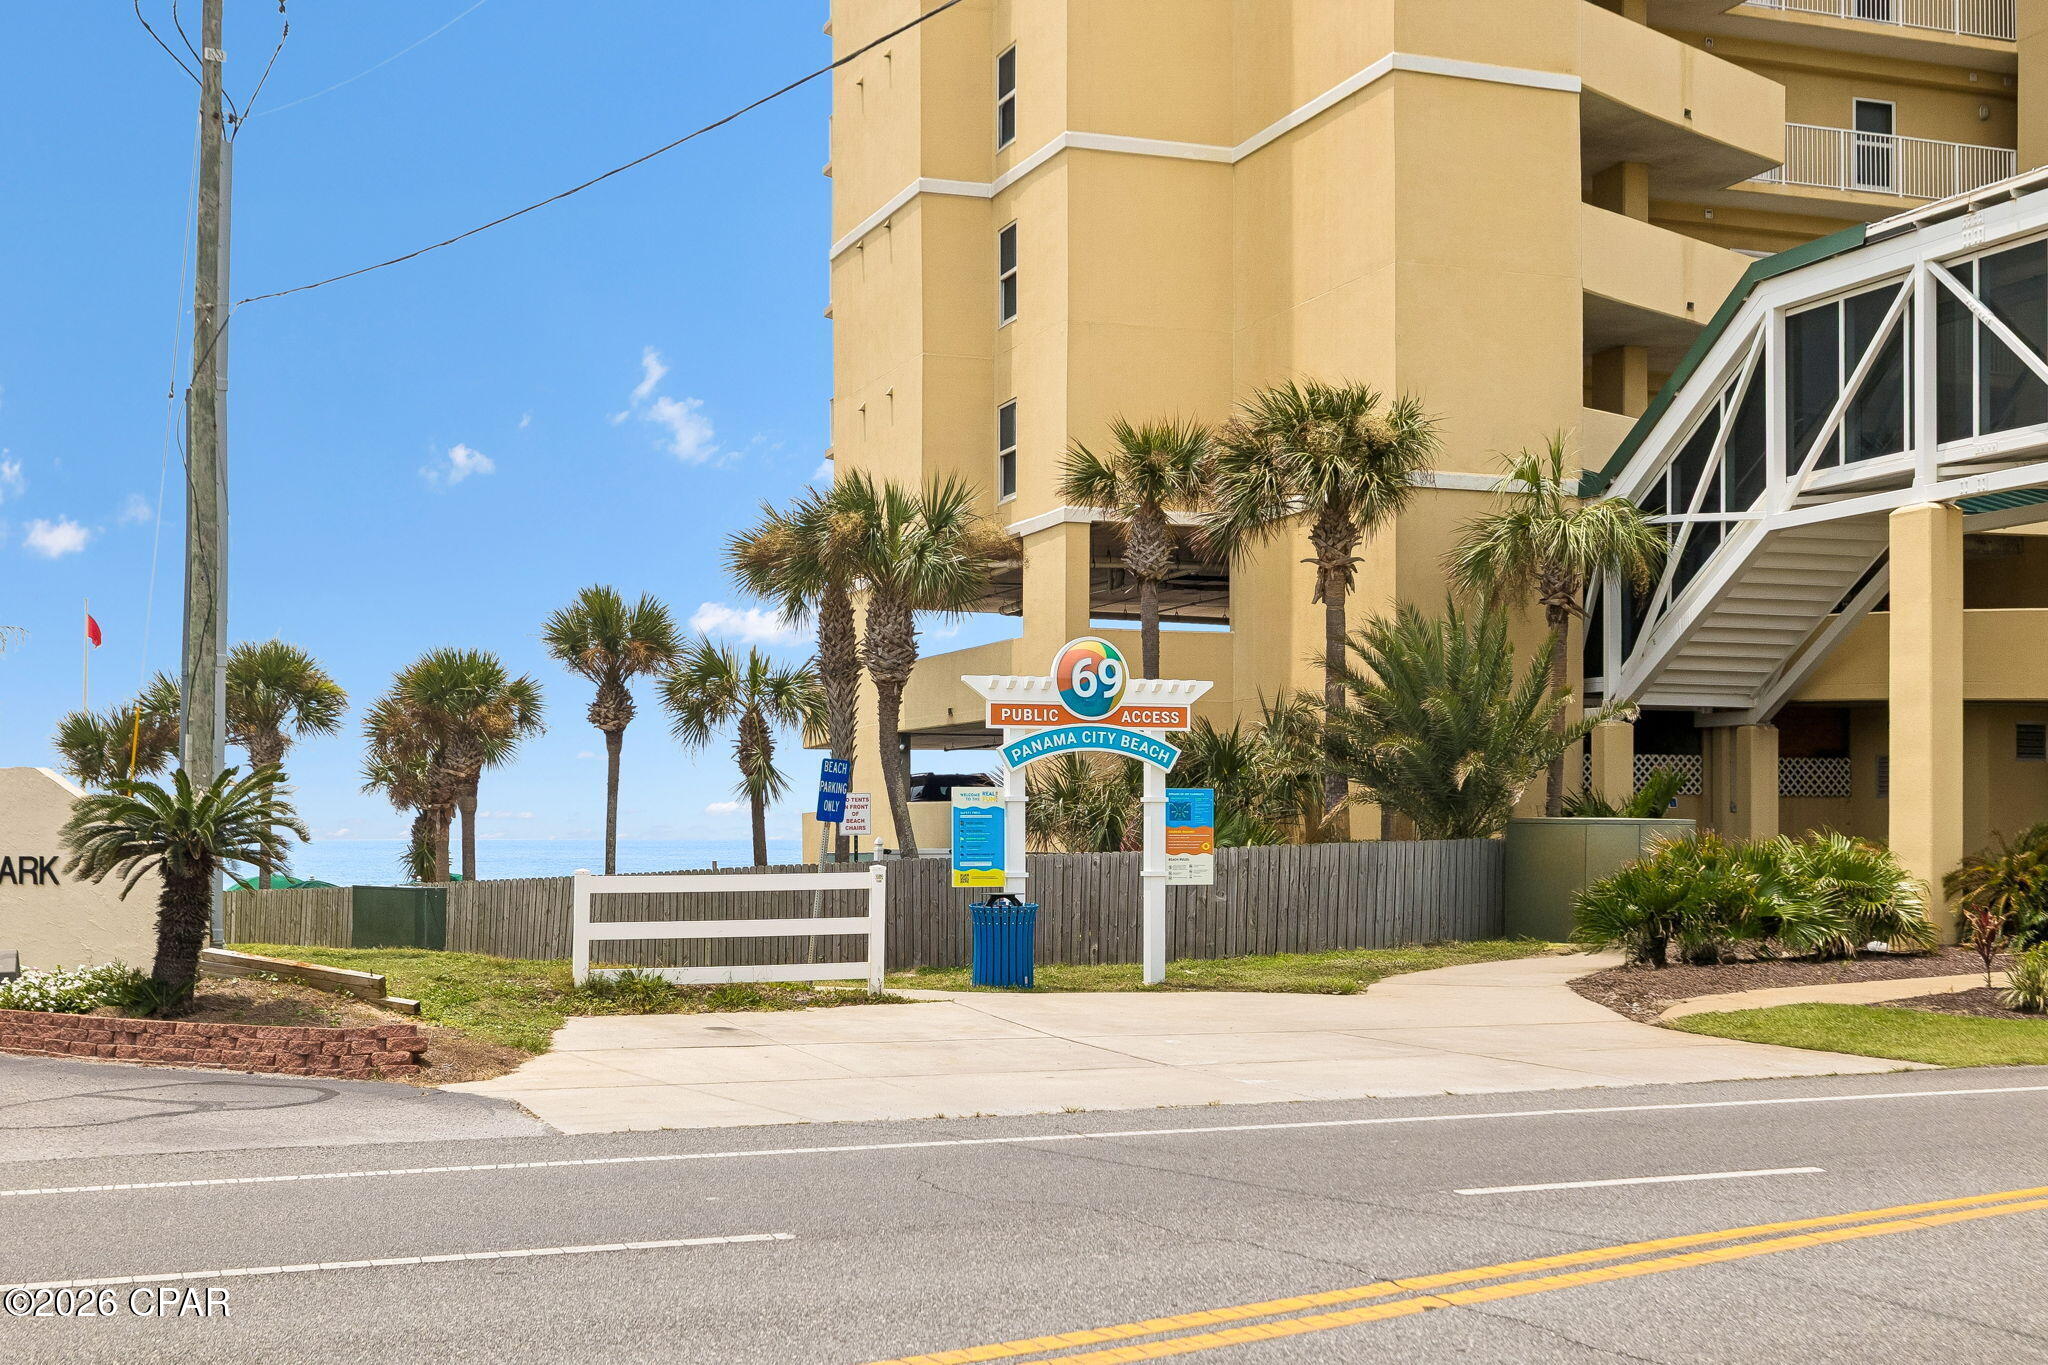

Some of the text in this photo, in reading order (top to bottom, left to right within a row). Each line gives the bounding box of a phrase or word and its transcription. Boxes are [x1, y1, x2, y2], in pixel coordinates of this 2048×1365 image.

[1071, 657, 1123, 699] 69
[1001, 708, 1180, 724] PUBLIC ACCESS
[1010, 730, 1171, 763] PANAMA CITY BEACH
[824, 760, 848, 775] BEACH
[820, 780, 848, 795] PARKING
[823, 799, 841, 812] ONLY
[0, 856, 60, 886] ARK
